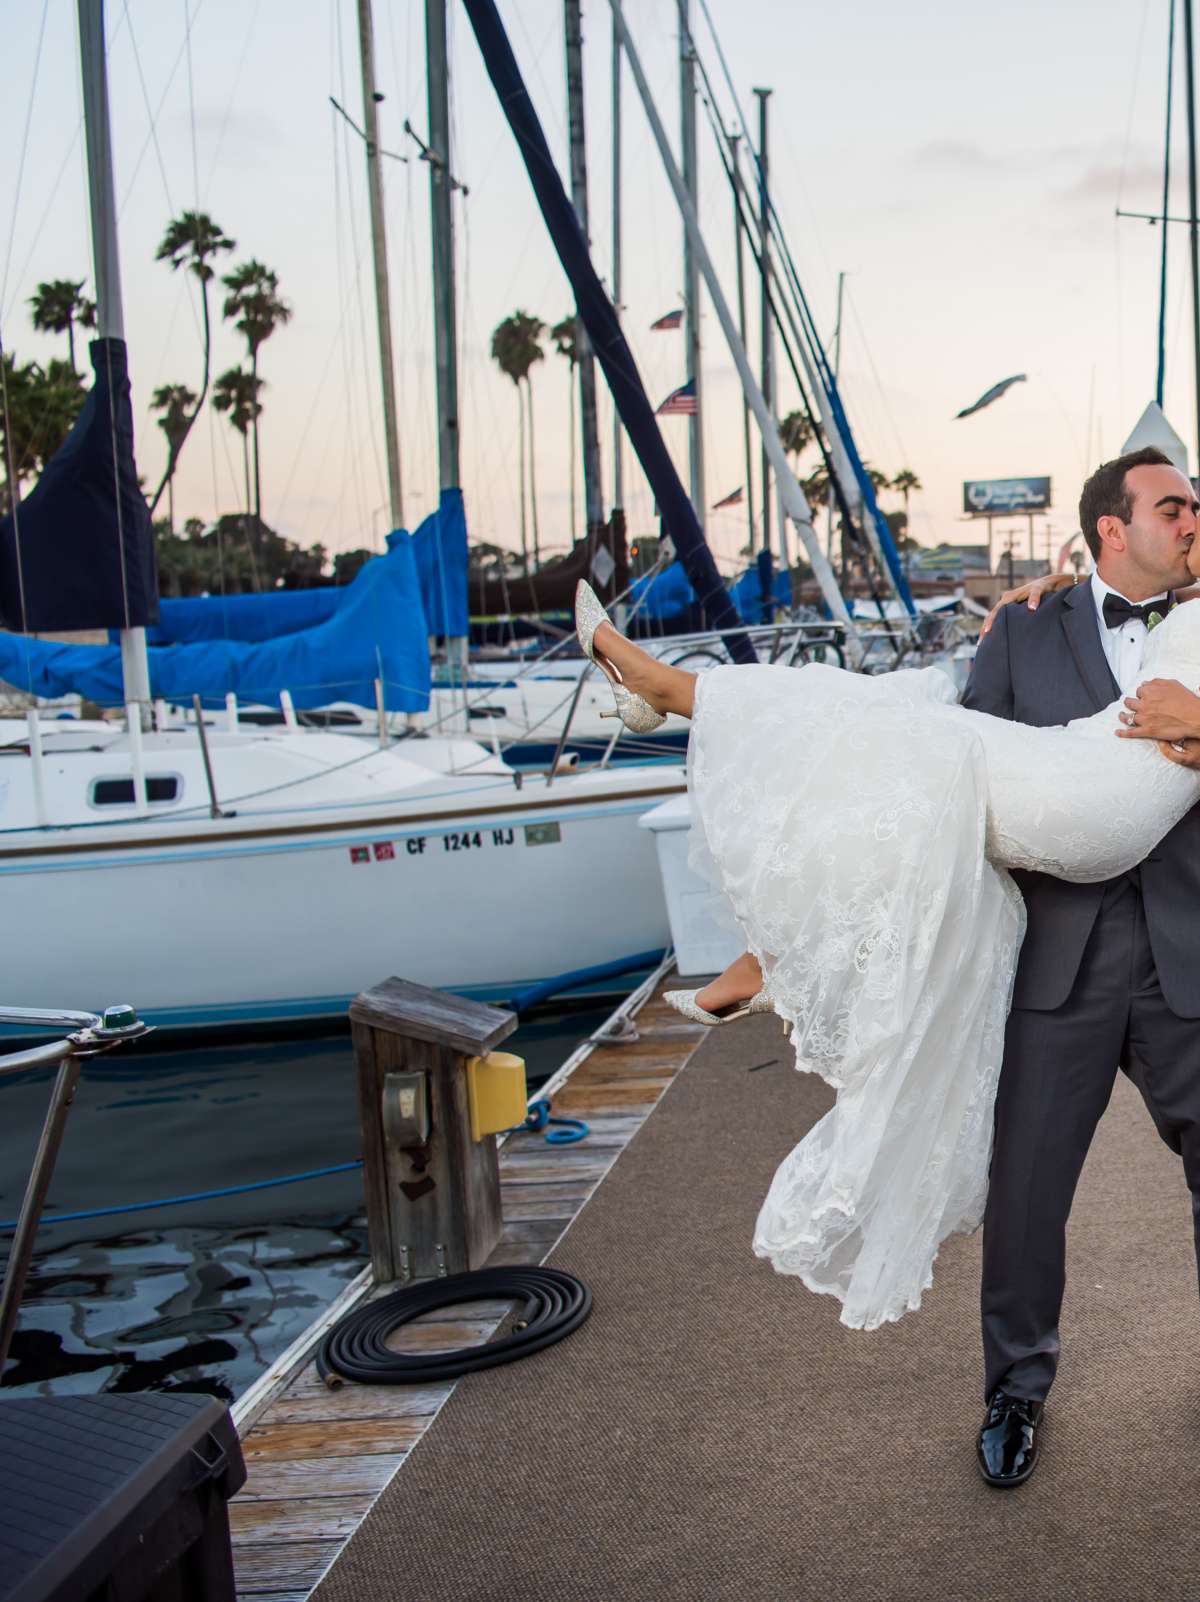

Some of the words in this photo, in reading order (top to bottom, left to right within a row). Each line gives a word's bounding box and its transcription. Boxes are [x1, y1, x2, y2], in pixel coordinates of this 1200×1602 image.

[406, 838, 426, 854] CF
[443, 832, 482, 851] 1244
[492, 829, 514, 846] HJ
